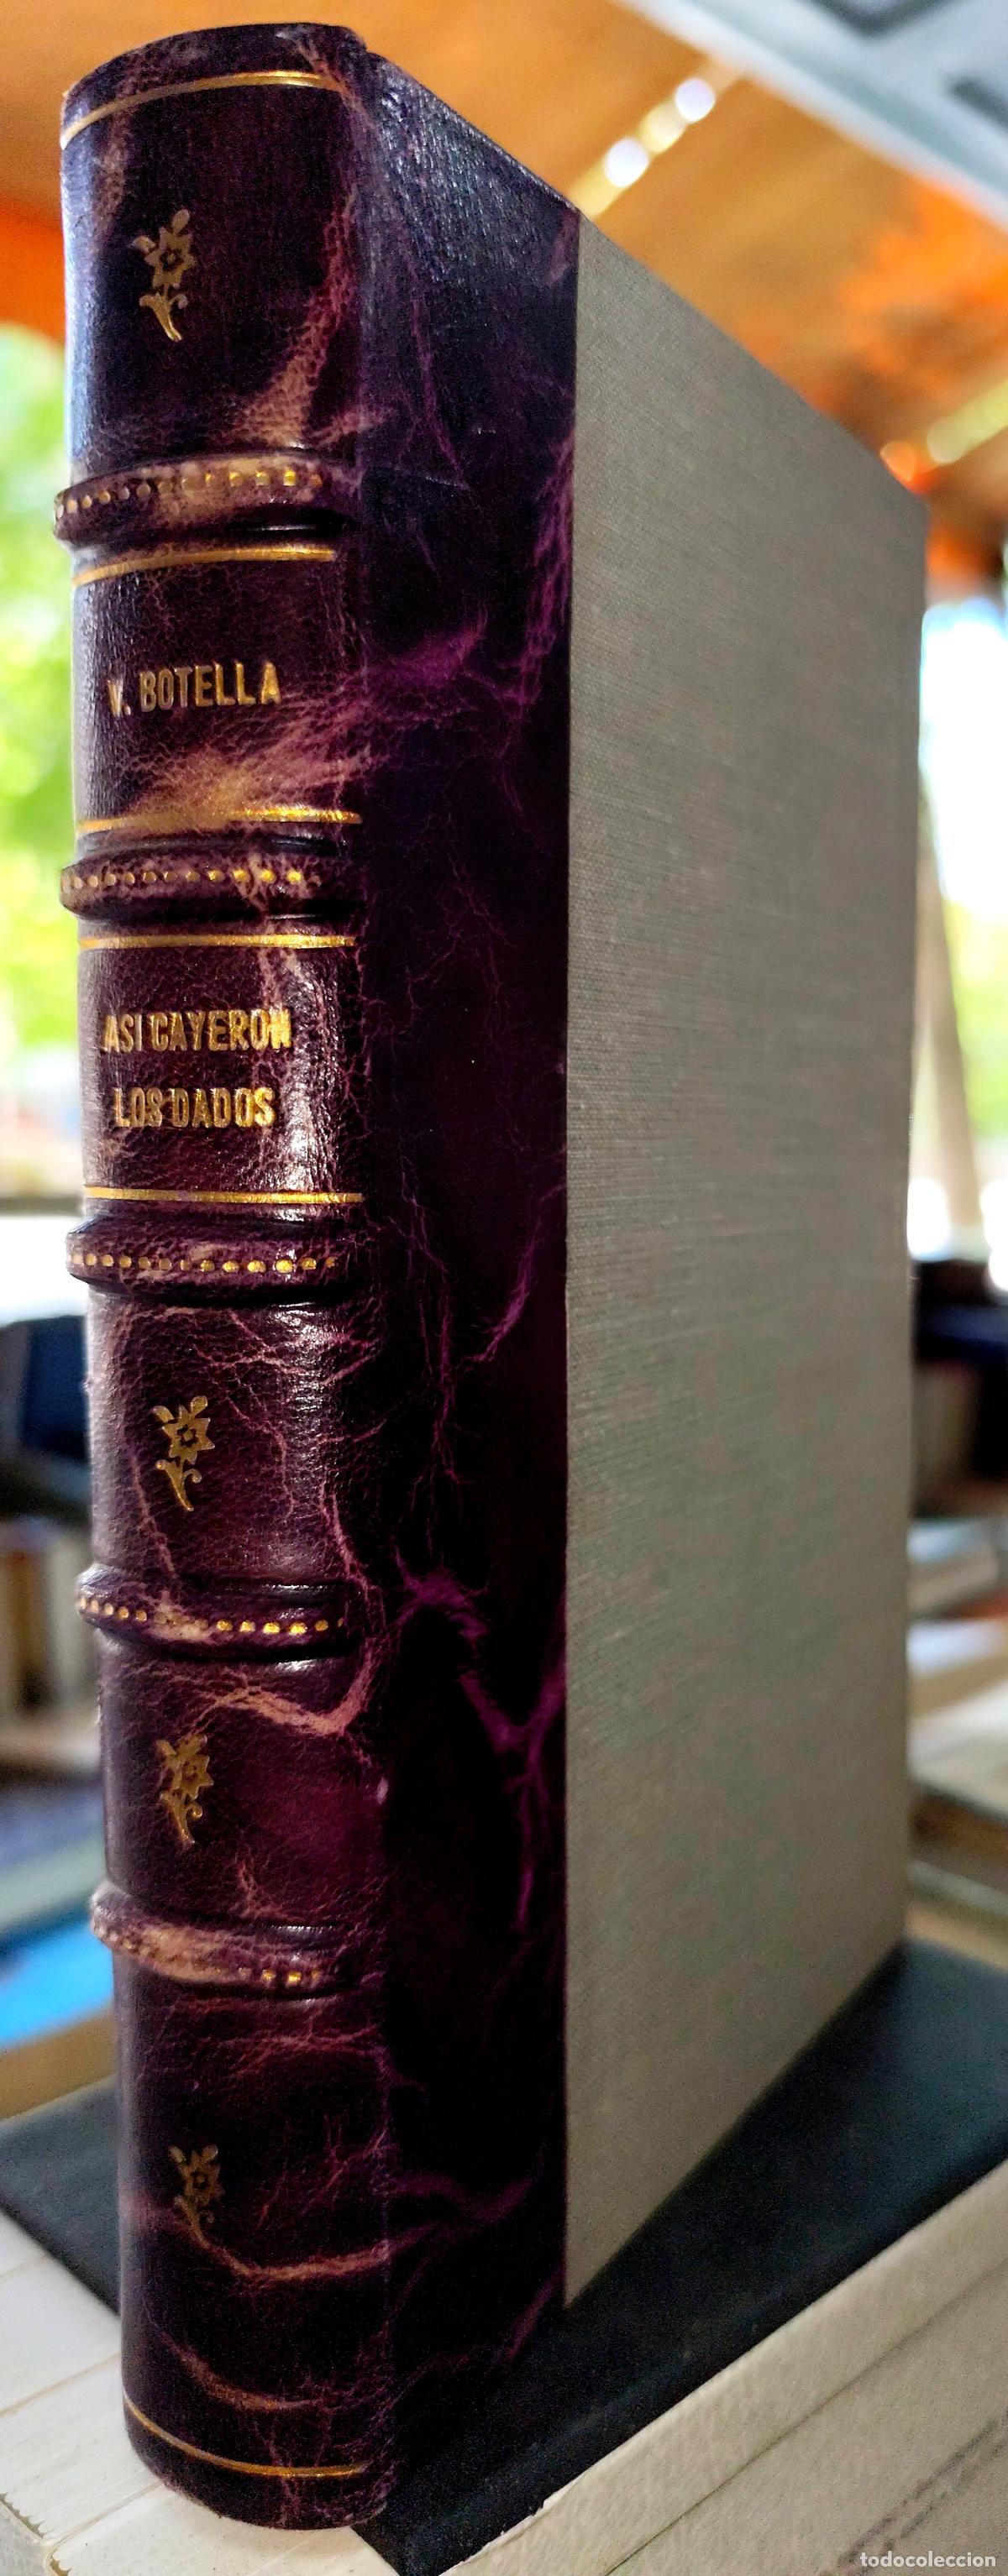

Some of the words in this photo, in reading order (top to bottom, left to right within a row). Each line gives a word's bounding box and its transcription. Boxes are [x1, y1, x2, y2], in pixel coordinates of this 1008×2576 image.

[108, 678, 131, 717] V.
[139, 660, 281, 712] BOTELLA
[102, 1013, 143, 1052] ASI
[150, 1008, 292, 1051] CAYERON
[113, 1087, 163, 1128] LOS
[171, 1087, 276, 1128] DADOS
